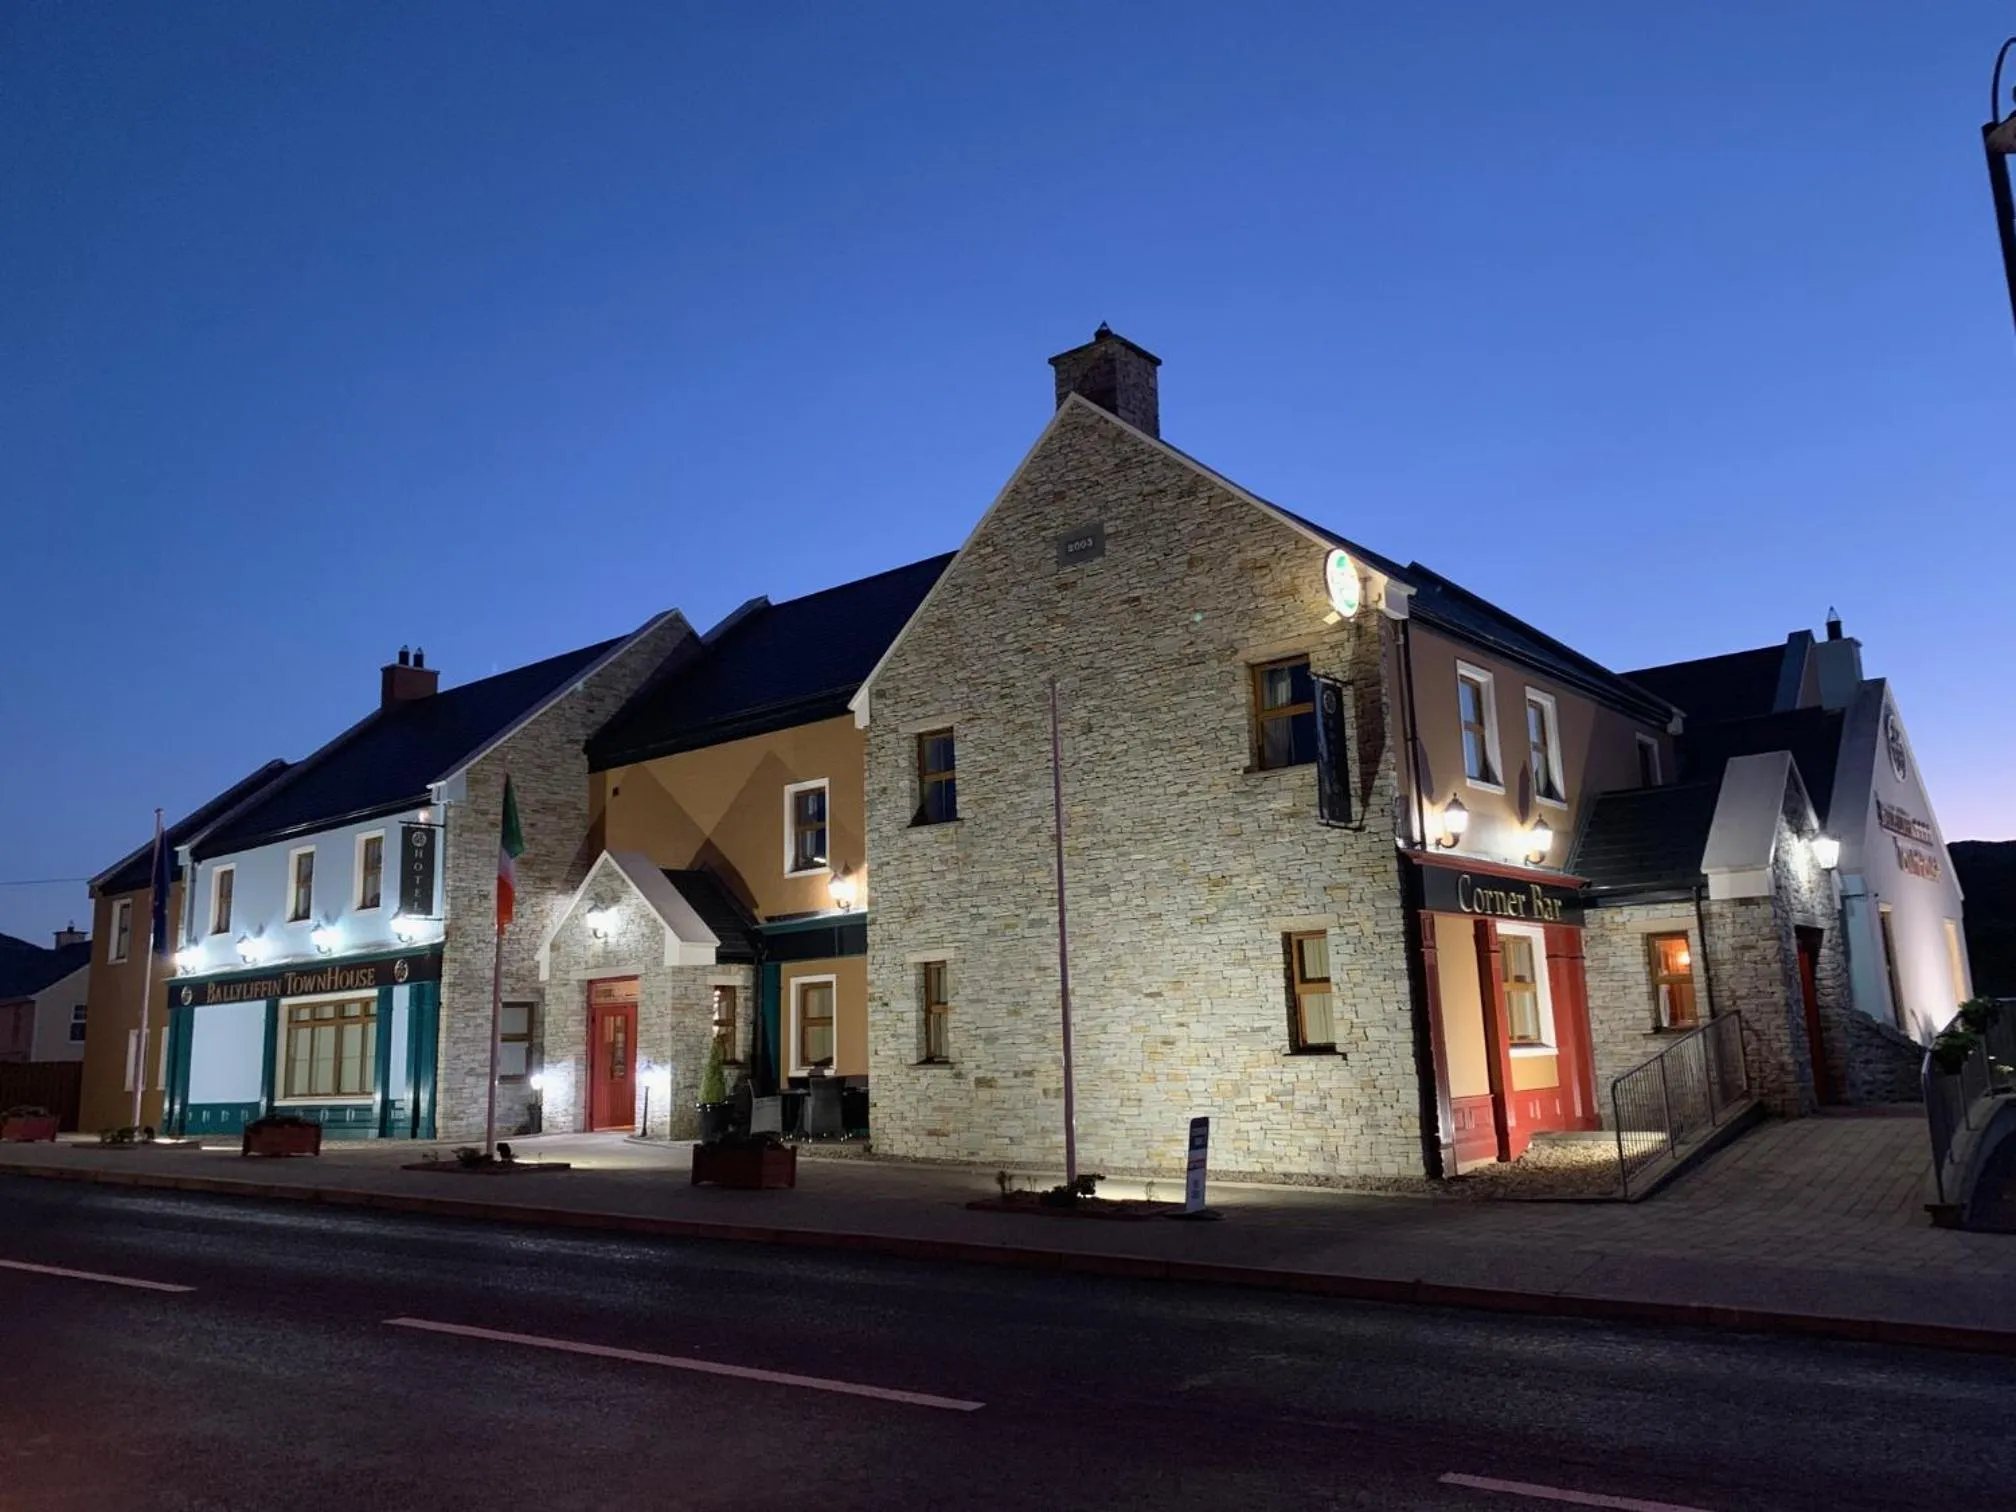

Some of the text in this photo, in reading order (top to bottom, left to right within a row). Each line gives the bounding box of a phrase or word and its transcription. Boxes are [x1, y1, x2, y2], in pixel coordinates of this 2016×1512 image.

[413, 848, 423, 910] HOTEL
[1457, 874, 1563, 921] Corner Bar
